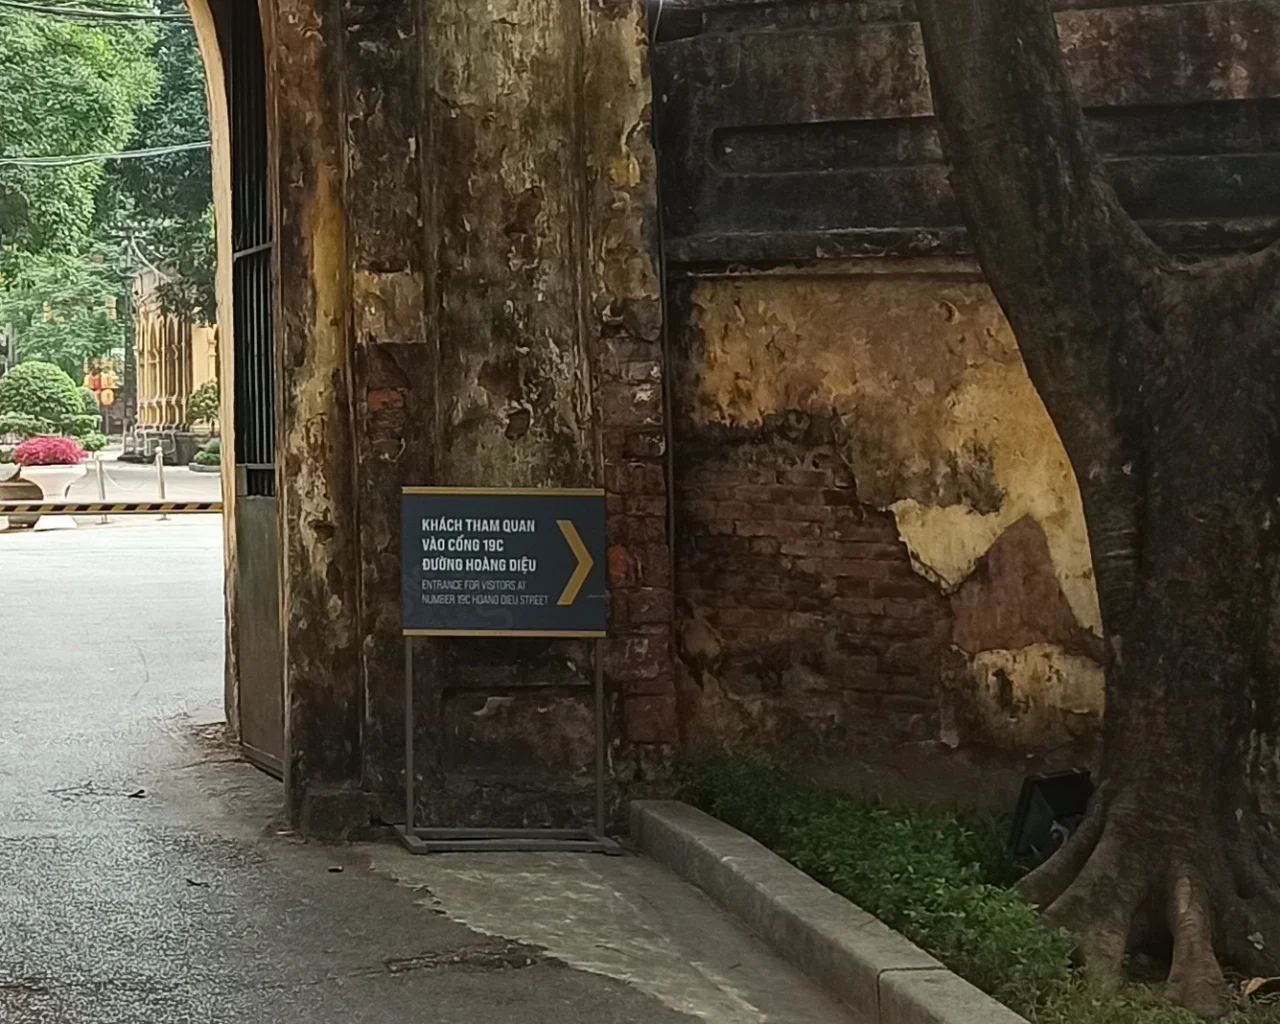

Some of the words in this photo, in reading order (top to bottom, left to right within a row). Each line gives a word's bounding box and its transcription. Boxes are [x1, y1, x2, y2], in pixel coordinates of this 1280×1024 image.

[422, 516, 462, 532] KHÁCH
[465, 519, 500, 532] THAM
[502, 519, 535, 533] QUAN
[422, 535, 445, 551] VÀO
[482, 539, 504, 551] 19C
[422, 555, 463, 571] ĐƯỜNG
[465, 555, 506, 571] HOÀNG
[509, 556, 537, 574] DIỆU
[422, 579, 463, 590] ENTRANCE
[464, 580, 480, 590] FOR
[481, 580, 516, 590] VISITORS
[517, 580, 527, 590] AT
[422, 594, 455, 604] NUMBER
[457, 594, 471, 604] 19C
[471, 595, 499, 604] HOANG
[500, 595, 518, 605] DIEU
[519, 595, 549, 605] STREET
